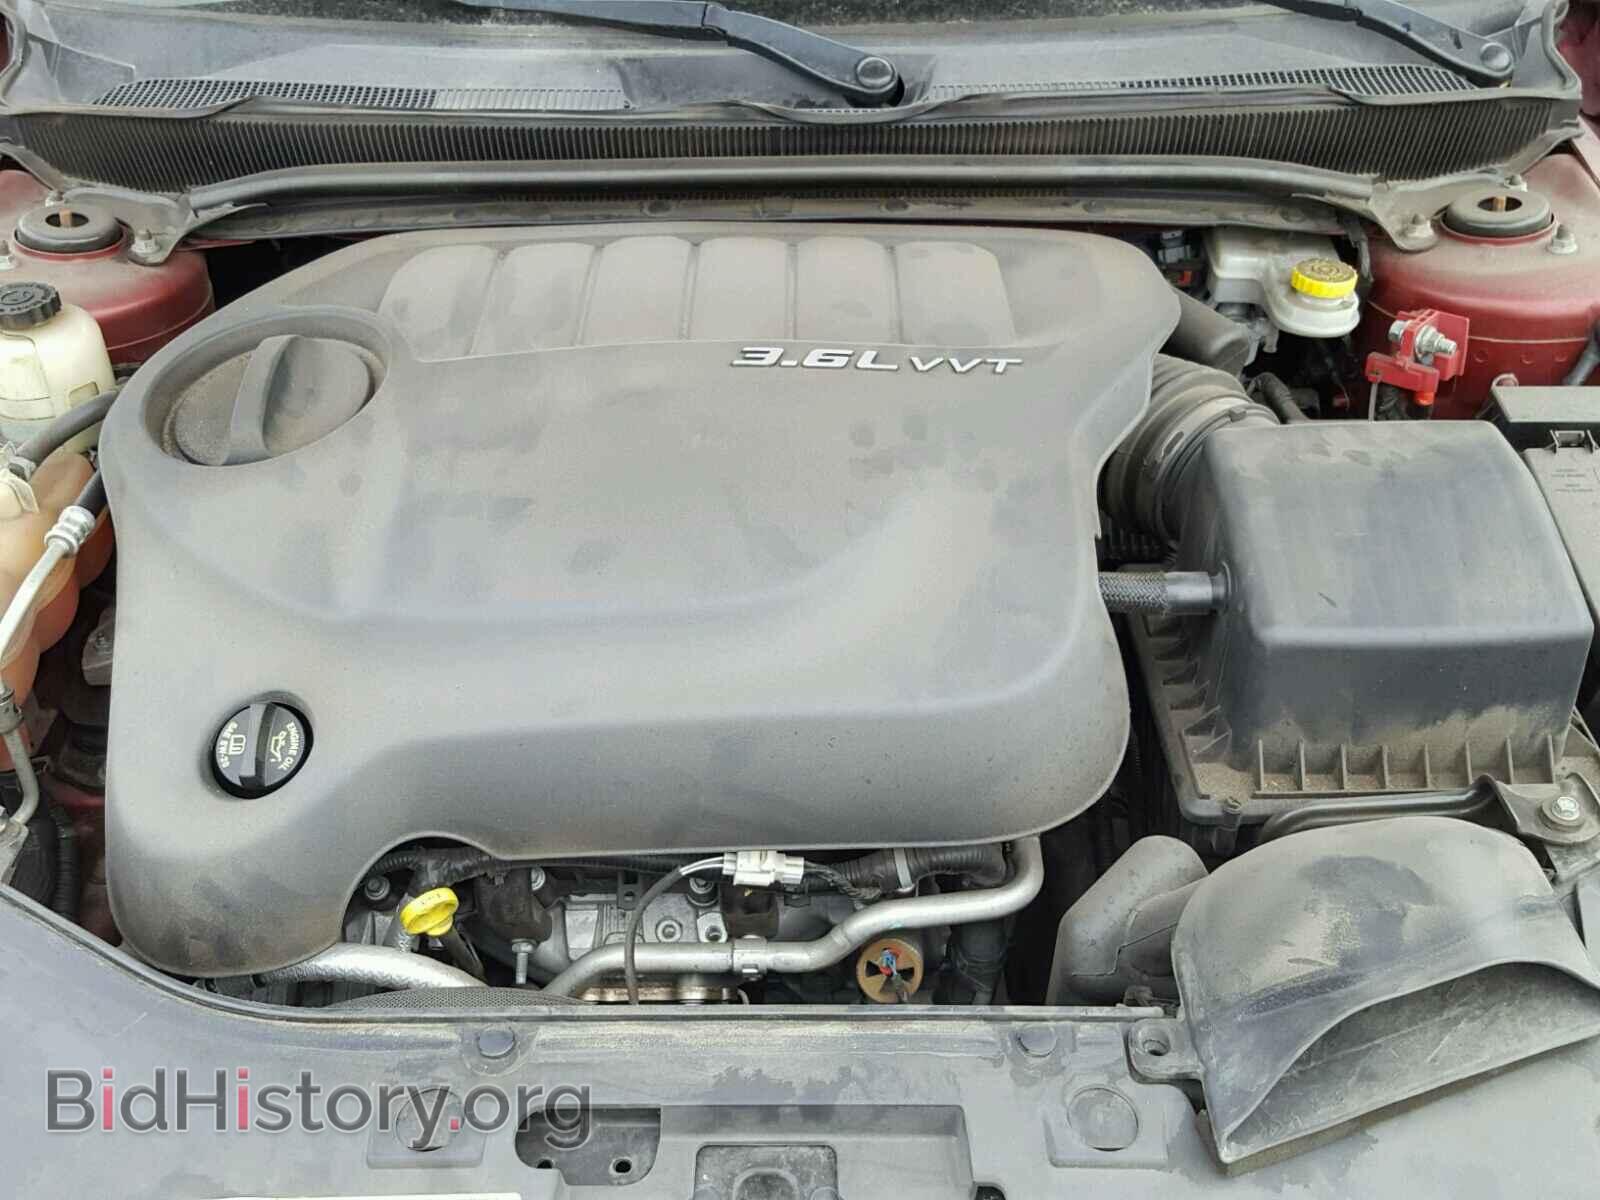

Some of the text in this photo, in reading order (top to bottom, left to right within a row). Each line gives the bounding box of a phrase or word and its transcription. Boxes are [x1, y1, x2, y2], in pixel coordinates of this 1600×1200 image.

[730, 346, 1023, 374] 3.6L VVT
[277, 721, 300, 771] ENGINE OIL
